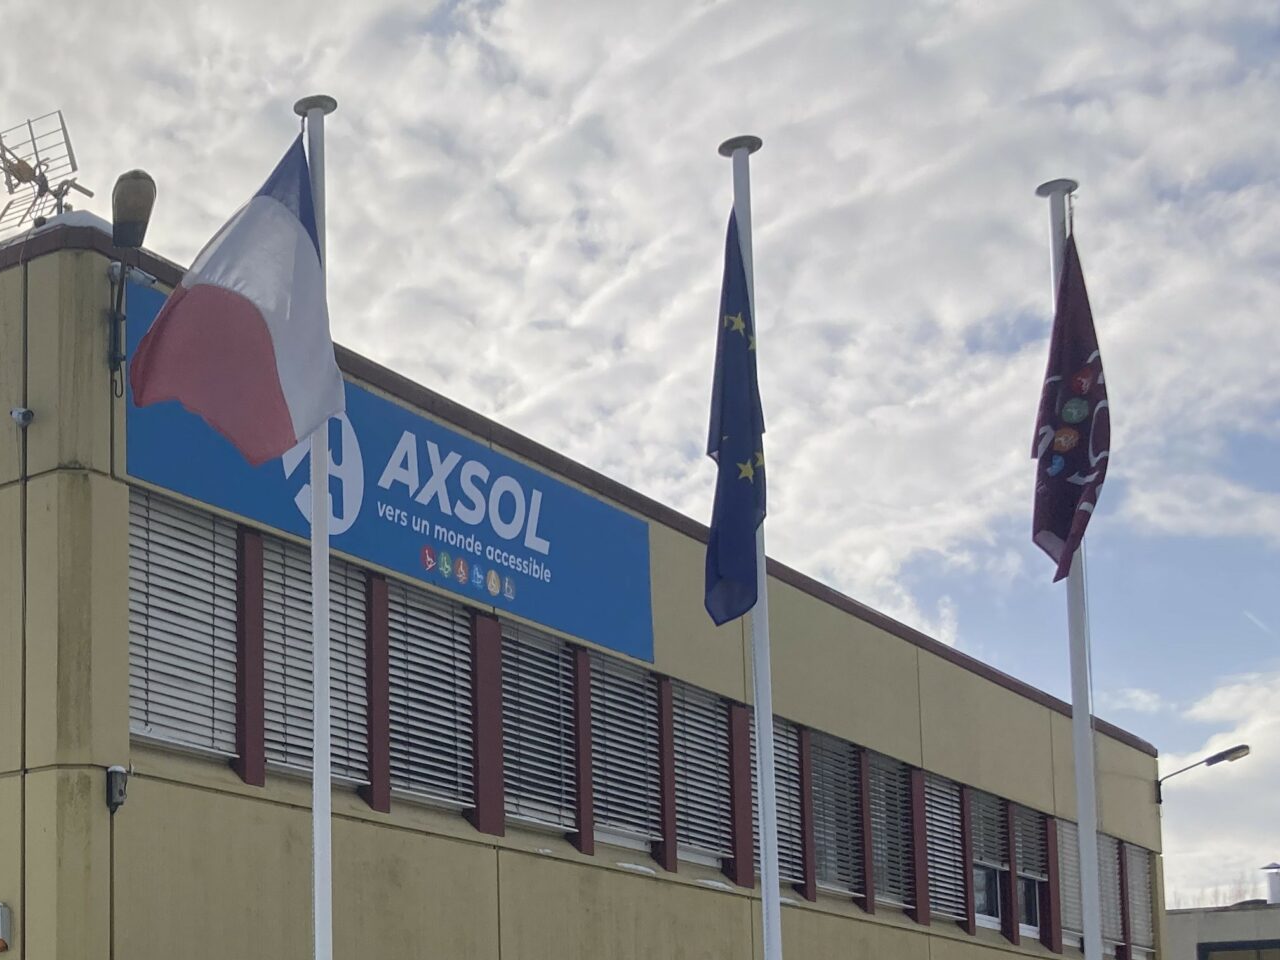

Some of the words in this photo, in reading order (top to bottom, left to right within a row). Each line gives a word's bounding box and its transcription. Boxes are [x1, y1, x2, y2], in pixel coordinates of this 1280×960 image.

[377, 430, 551, 555] AXSOL
[377, 501, 408, 527] vers
[412, 514, 430, 536] un
[434, 524, 482, 556] monde
[486, 545, 552, 583] accessible
